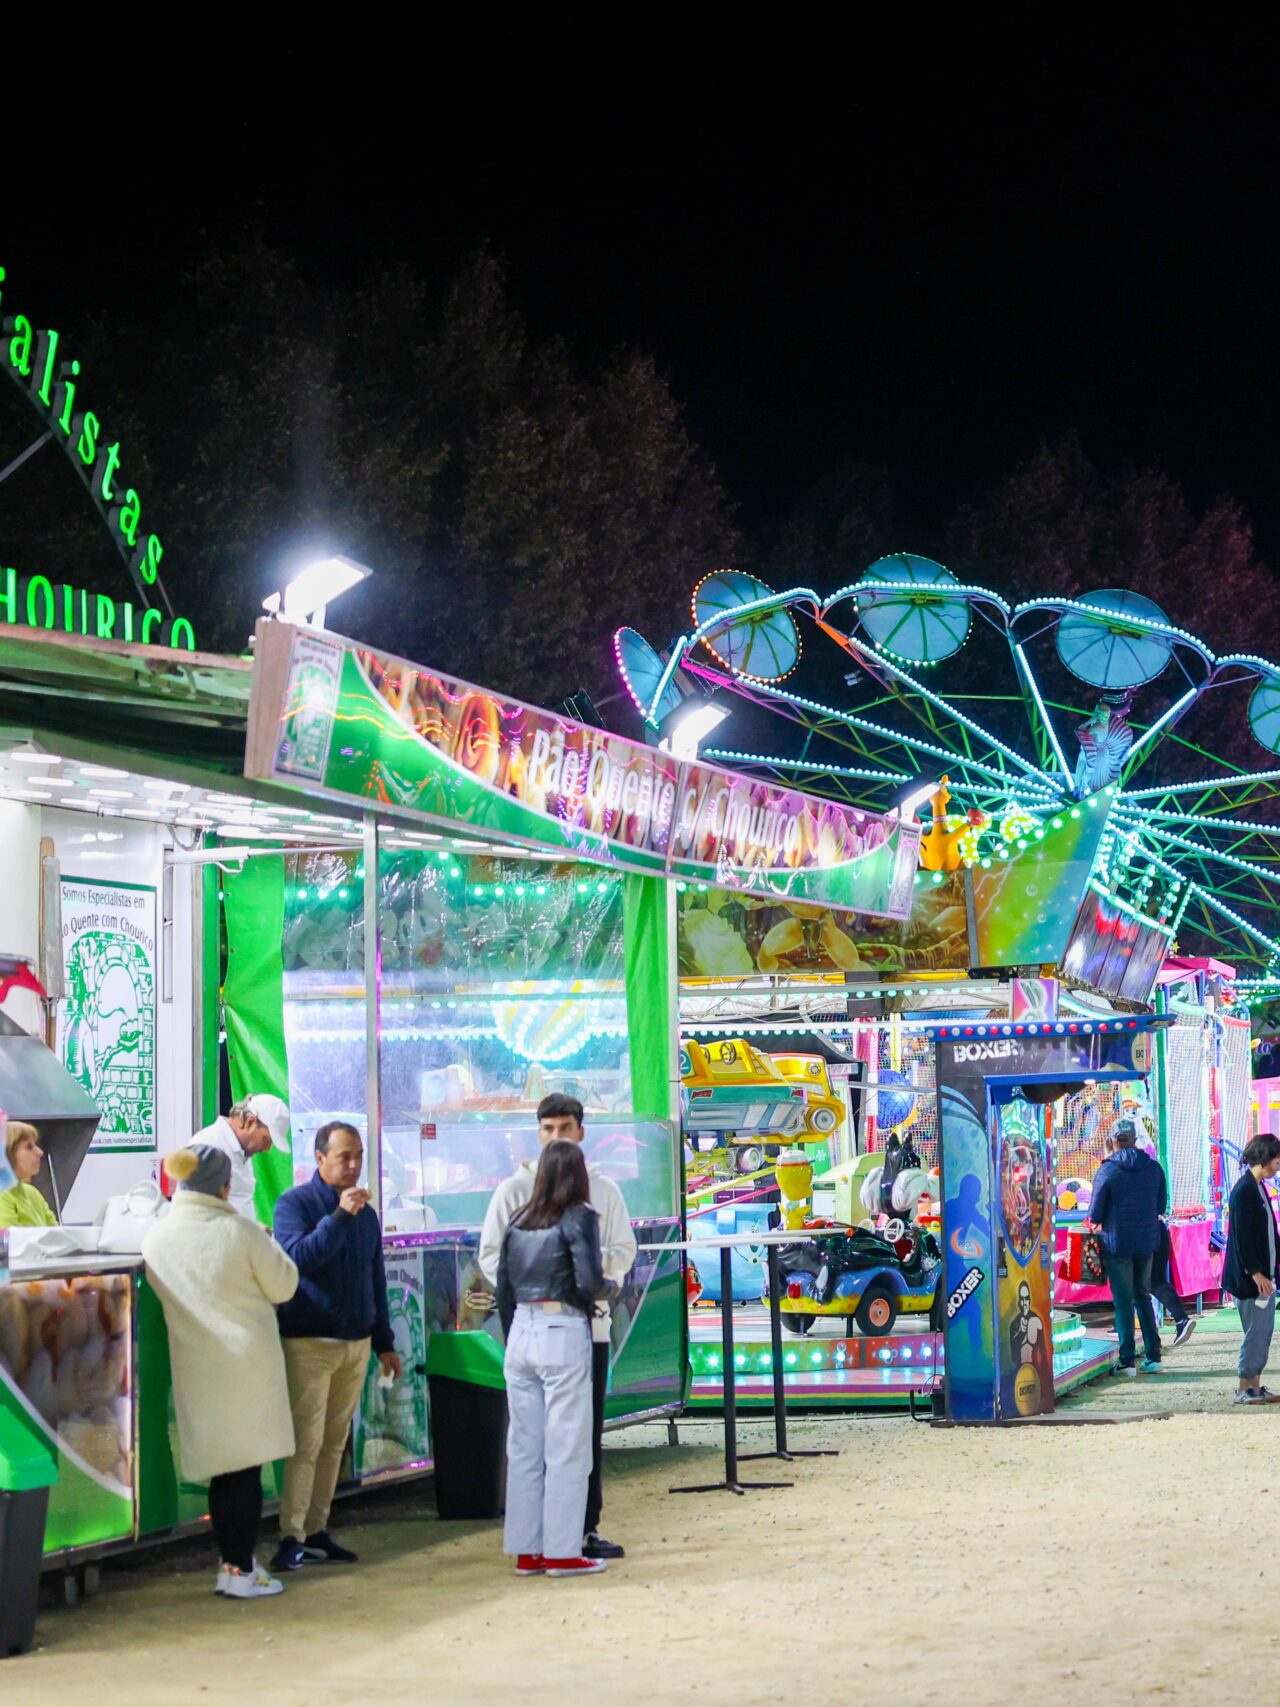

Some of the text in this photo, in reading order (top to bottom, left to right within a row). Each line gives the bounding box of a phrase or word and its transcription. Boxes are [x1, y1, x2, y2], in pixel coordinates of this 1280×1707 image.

[0, 266, 163, 584] alistas
[529, 729, 580, 797] Pão
[589, 749, 675, 822] Quente
[62, 886, 145, 909] Somos Especialistas em
[70, 914, 99, 934] Quente
[101, 914, 118, 928] com
[953, 1038, 1018, 1063] BOXER
[947, 1268, 983, 1318] BOXER
